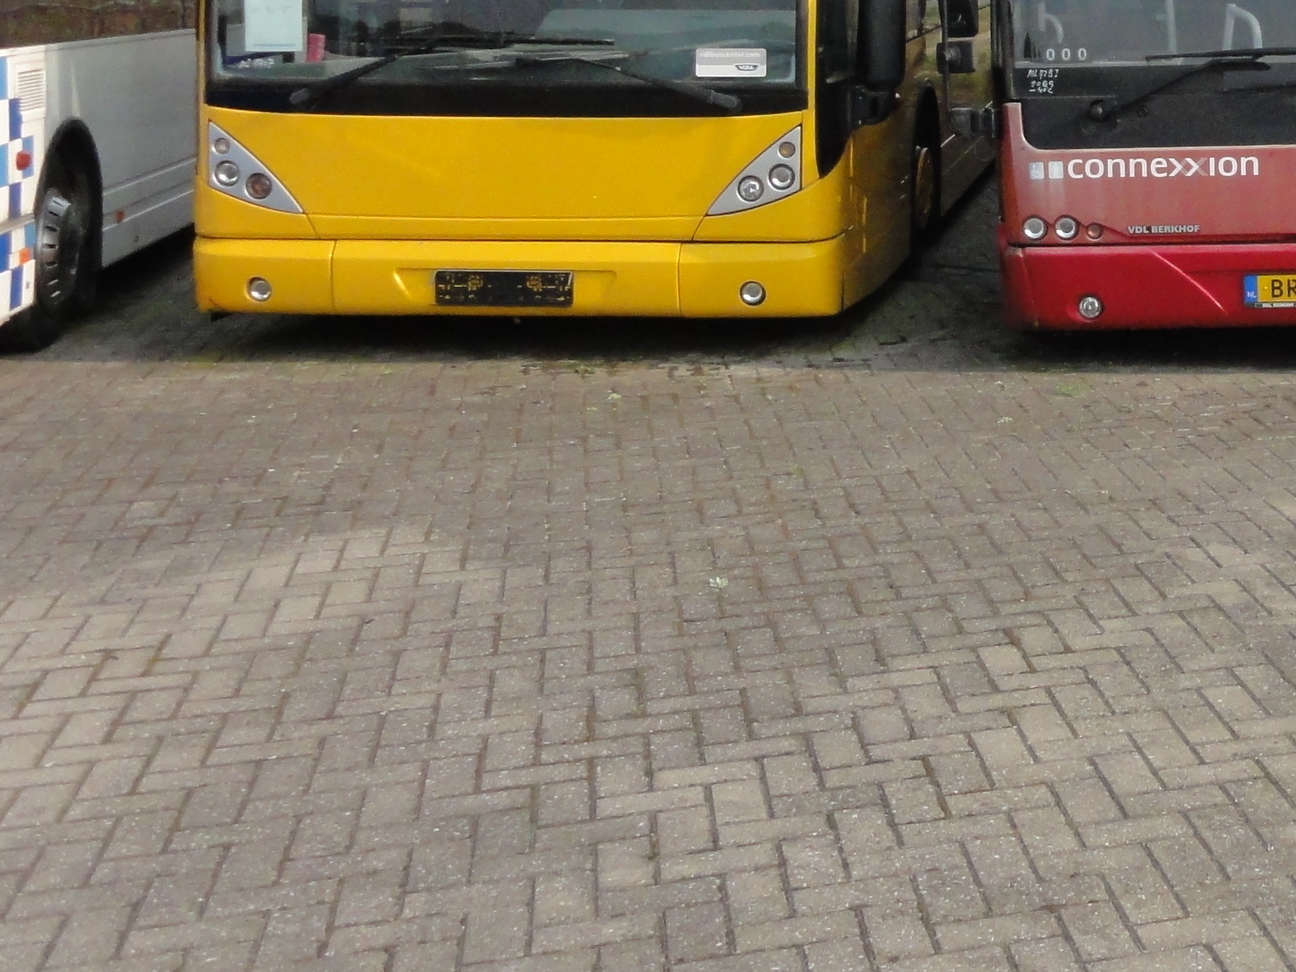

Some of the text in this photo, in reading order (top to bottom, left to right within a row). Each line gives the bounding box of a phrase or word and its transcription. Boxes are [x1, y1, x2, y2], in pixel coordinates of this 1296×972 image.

[1067, 155, 1259, 179] connexxion
[1127, 225, 1200, 234] VDL BERKHOF
